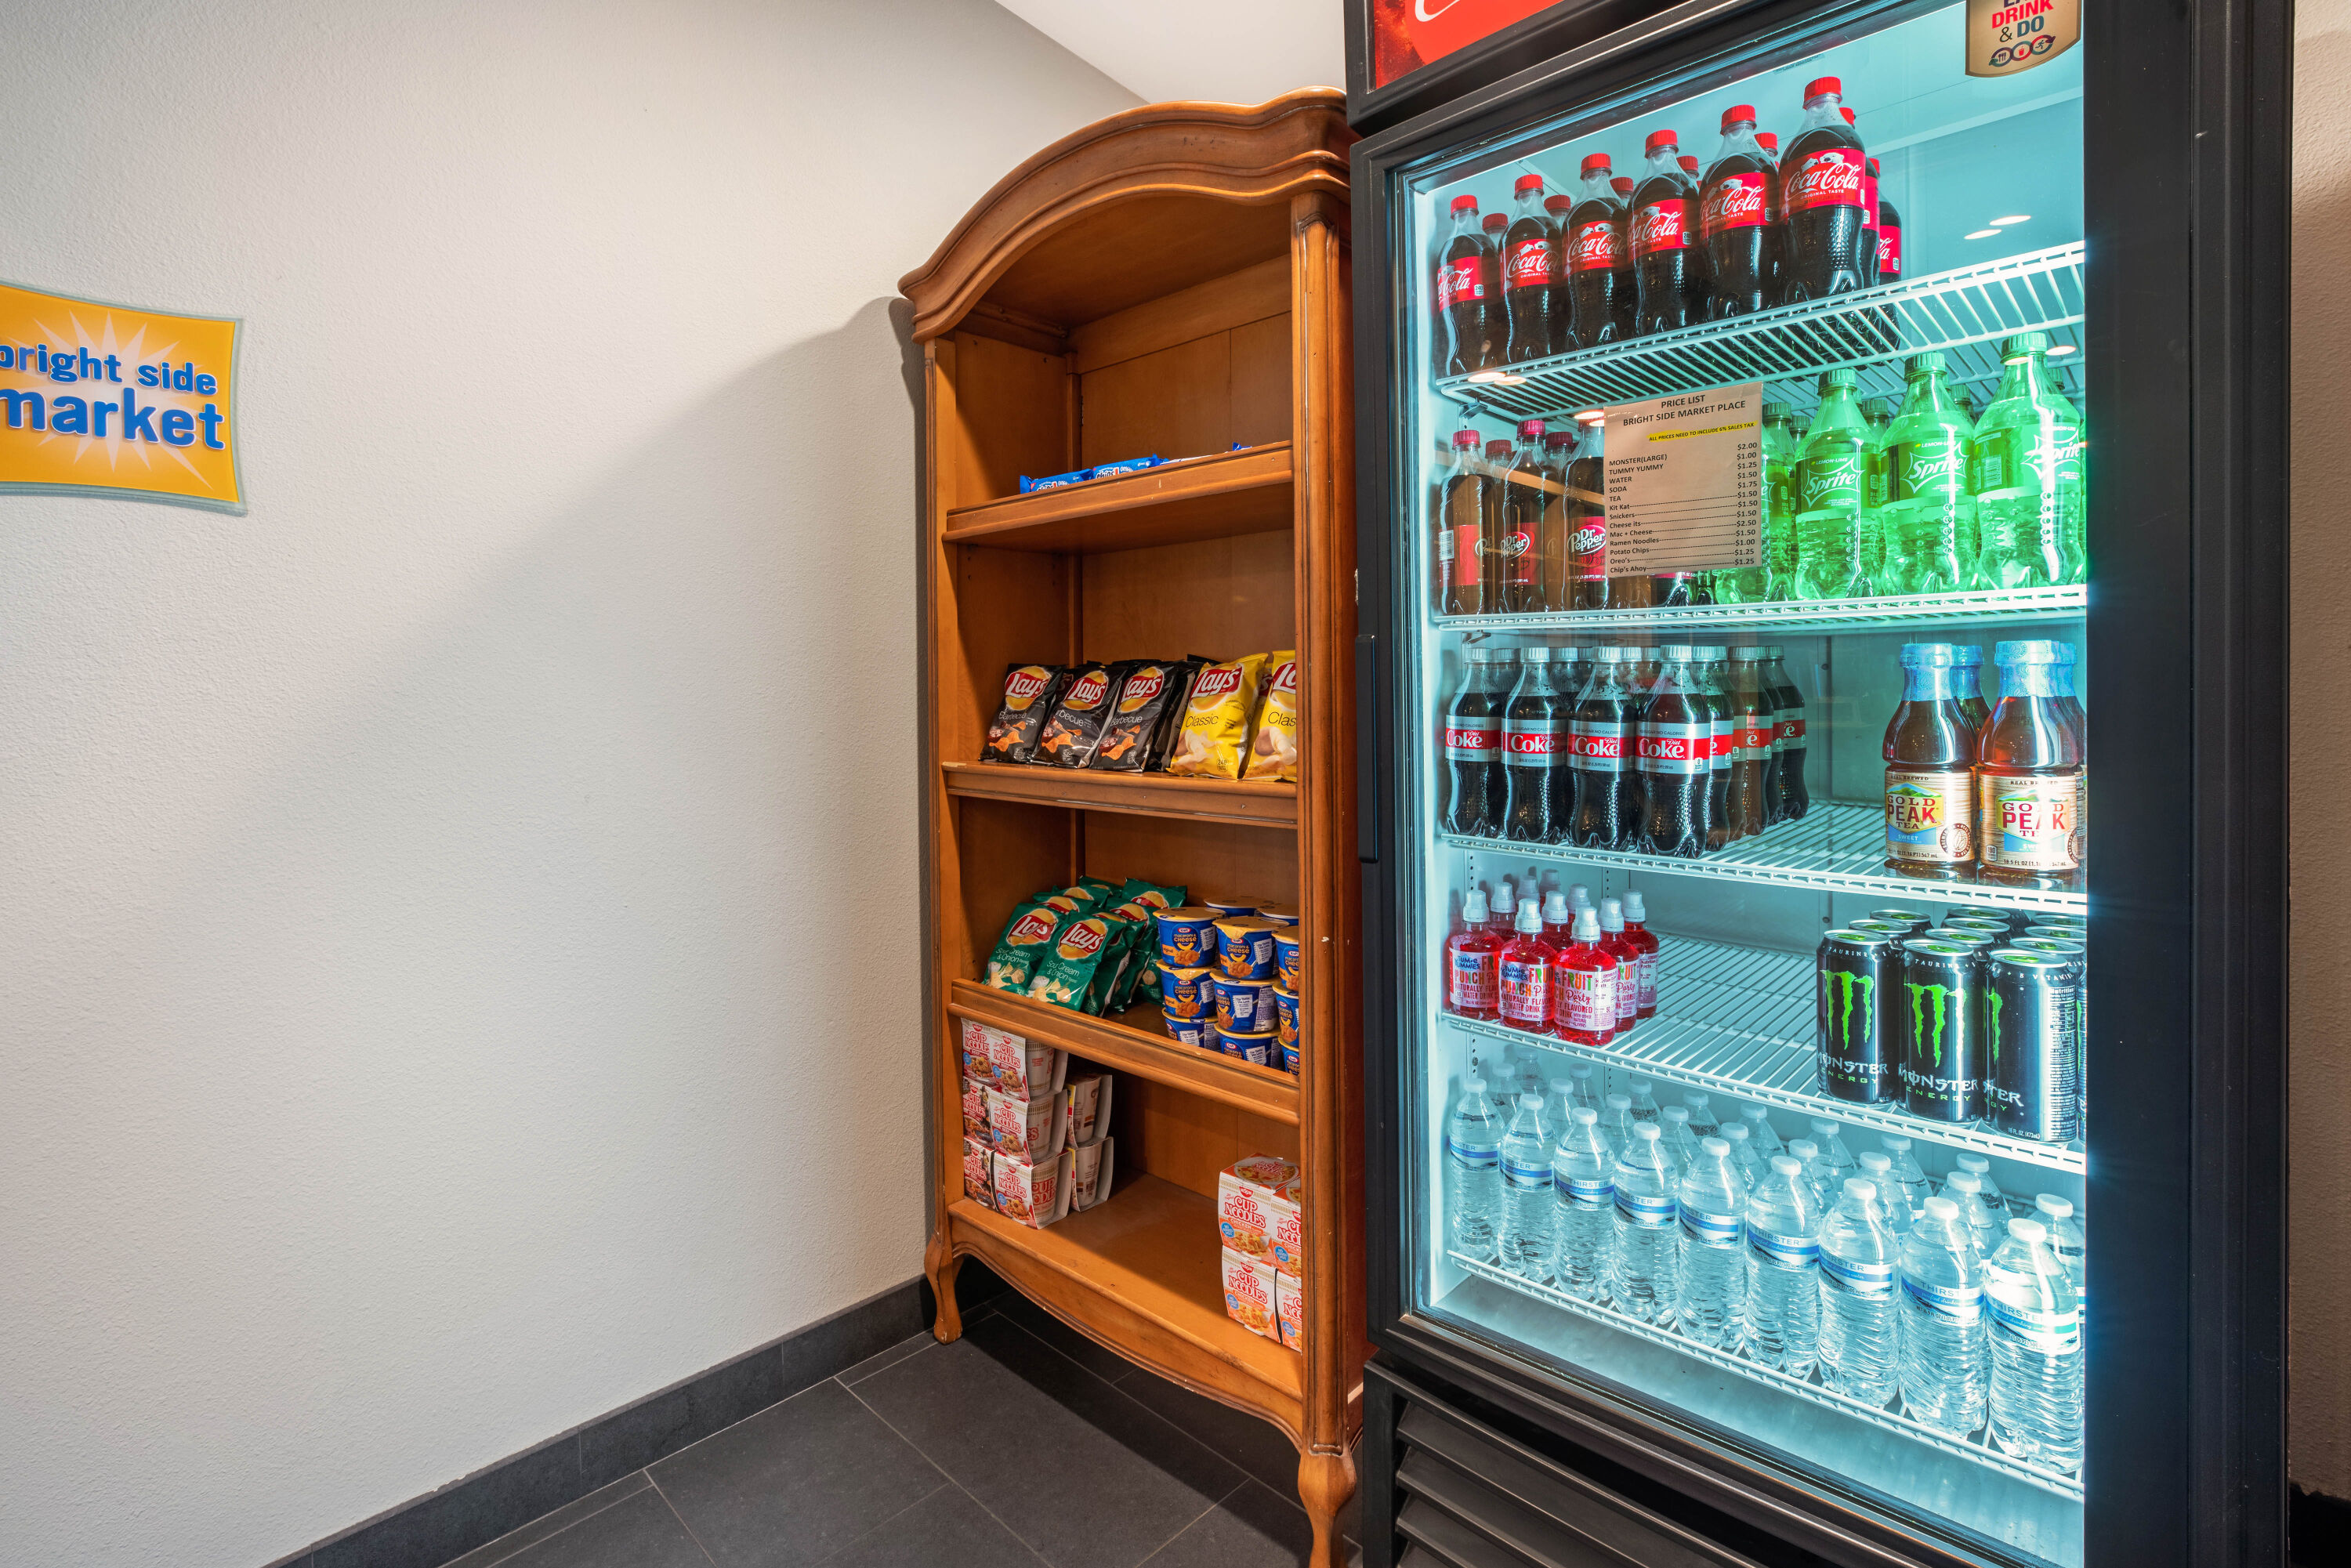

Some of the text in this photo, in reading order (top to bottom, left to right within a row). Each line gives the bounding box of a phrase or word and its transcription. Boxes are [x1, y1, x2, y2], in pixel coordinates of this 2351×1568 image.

[1992, 0, 2054, 29] DRINK
[1999, 15, 2045, 42] & DO
[1784, 163, 1861, 201] Coca-Cola
[136, 361, 218, 397] side
[1661, 395, 1705, 408] PRICE LIST
[0, 387, 226, 451] market
[1623, 400, 1746, 426] BRIGHT SIDE MARKET PLACE
[1737, 442, 1758, 451] $2.00
[1609, 454, 1758, 470] MONSTER(LARGE) $1.25
[1737, 451, 1757, 461] $1.00
[1609, 464, 1758, 480] TUMMY YUMMY $1.50
[1609, 476, 1632, 484] WATER
[1737, 481, 1758, 490] $1.75
[1806, 471, 1857, 495] Sprite
[1737, 491, 1758, 499] $1.50
[1737, 500, 1758, 509] $1.50
[1737, 509, 1757, 518] $1.50
[1737, 520, 1757, 528] $2.50
[1507, 534, 1517, 545] Dr
[1580, 528, 1596, 539] Dr
[1736, 529, 1755, 538] $1.50
[1568, 532, 1606, 553] Pepper
[1735, 538, 1755, 547] $1.00
[1734, 549, 1755, 557] $1.25
[1734, 558, 1755, 567] $1.25
[1005, 673, 1047, 697] Lay's
[1121, 676, 1161, 702] Lay's
[1191, 666, 1240, 697] Lay's
[1068, 679, 1106, 704] Lay's
[998, 711, 1027, 719] Barbecue
[1110, 715, 1143, 726] Barbecue
[1186, 714, 1219, 728] Classic
[1268, 712, 1297, 726] Clas
[1447, 730, 1483, 748] Coke
[1511, 734, 1555, 752] Coke
[1574, 737, 1621, 757] Coke
[1639, 738, 1685, 759] Coke
[1887, 795, 1936, 806] GOLD
[2002, 802, 2063, 812] GOD
[1887, 804, 1937, 823] PEAK
[1060, 923, 1104, 950] Lay's
[1828, 947, 1868, 958] TAURINE
[1058, 962, 1080, 976] Cream
[1914, 958, 1960, 969] TAURINE
[1454, 969, 1485, 984] PUNCH
[1562, 970, 1592, 991] FRUIT
[1501, 980, 1531, 997] PUNCH
[1616, 982, 1636, 994] Party
[1567, 989, 1592, 1005] Party
[1559, 1009, 1573, 1019] DRINK
[1564, 1002, 1592, 1013] FLAVORED
[970, 1031, 987, 1042] CUP
[1000, 1043, 1015, 1056] CUP
[994, 1049, 1020, 1068] NOODLES
[1817, 1052, 1889, 1074] MONSTER
[1820, 1067, 1879, 1085] ENERGY
[1899, 1066, 1979, 1092] MONSTER
[968, 1092, 980, 1105] CUP
[1906, 1085, 1971, 1102] ENERGY
[963, 1098, 986, 1117] NOODLES
[1000, 1108, 1016, 1121] CUP
[994, 1113, 1021, 1134] NOODLES
[969, 1155, 982, 1168] CUP
[964, 1160, 987, 1181] NOODLES
[1005, 1171, 1020, 1185] CUP
[998, 1177, 1027, 1198] NOODLES
[1568, 1178, 1609, 1187] THIRSTER
[1234, 1195, 1258, 1211] CUP
[1224, 1201, 1266, 1228] NOODLES
[1231, 1219, 1252, 1229] CHICKEN
[1754, 1227, 1800, 1246] THIRSTER
[1237, 1269, 1259, 1287] CUP
[1229, 1275, 1268, 1305] NOODLES
